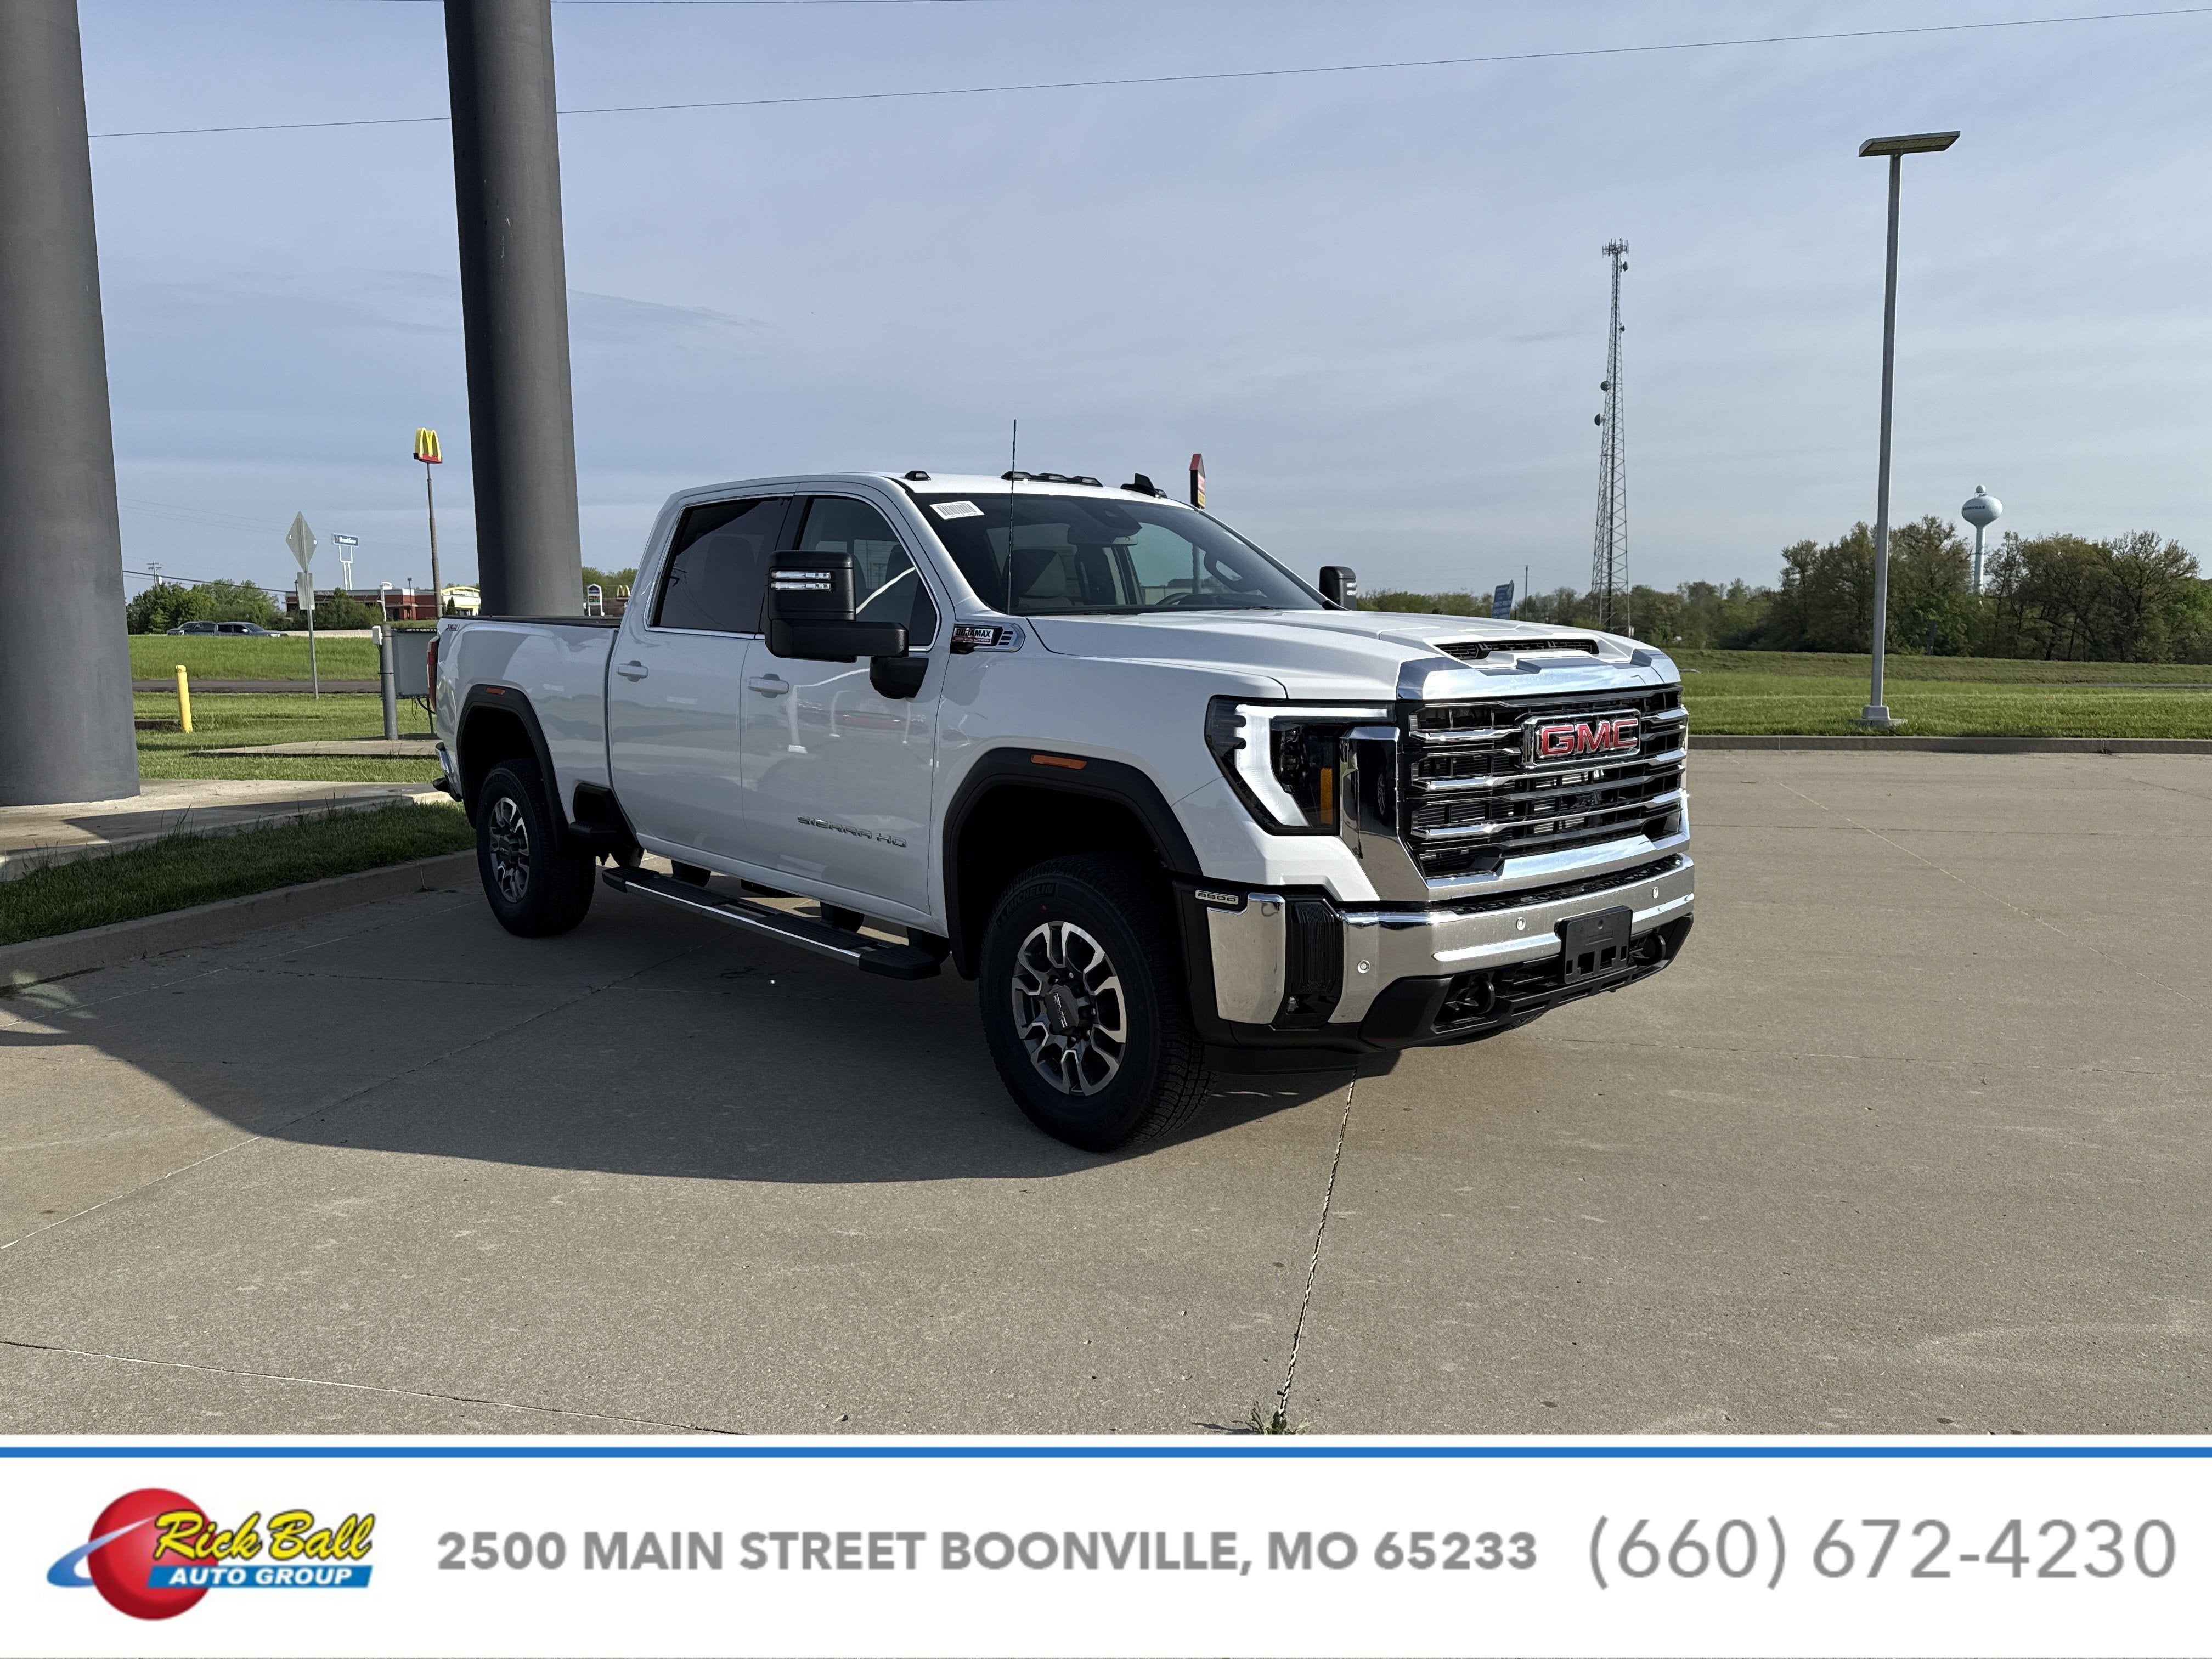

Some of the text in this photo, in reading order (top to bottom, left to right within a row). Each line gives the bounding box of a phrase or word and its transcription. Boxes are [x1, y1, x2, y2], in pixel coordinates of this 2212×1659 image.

[956, 628, 991, 638] DURAMAX
[1537, 718, 1638, 758] GMC
[797, 816, 907, 848] SIERRA HD
[1197, 892, 1237, 902] 2500
